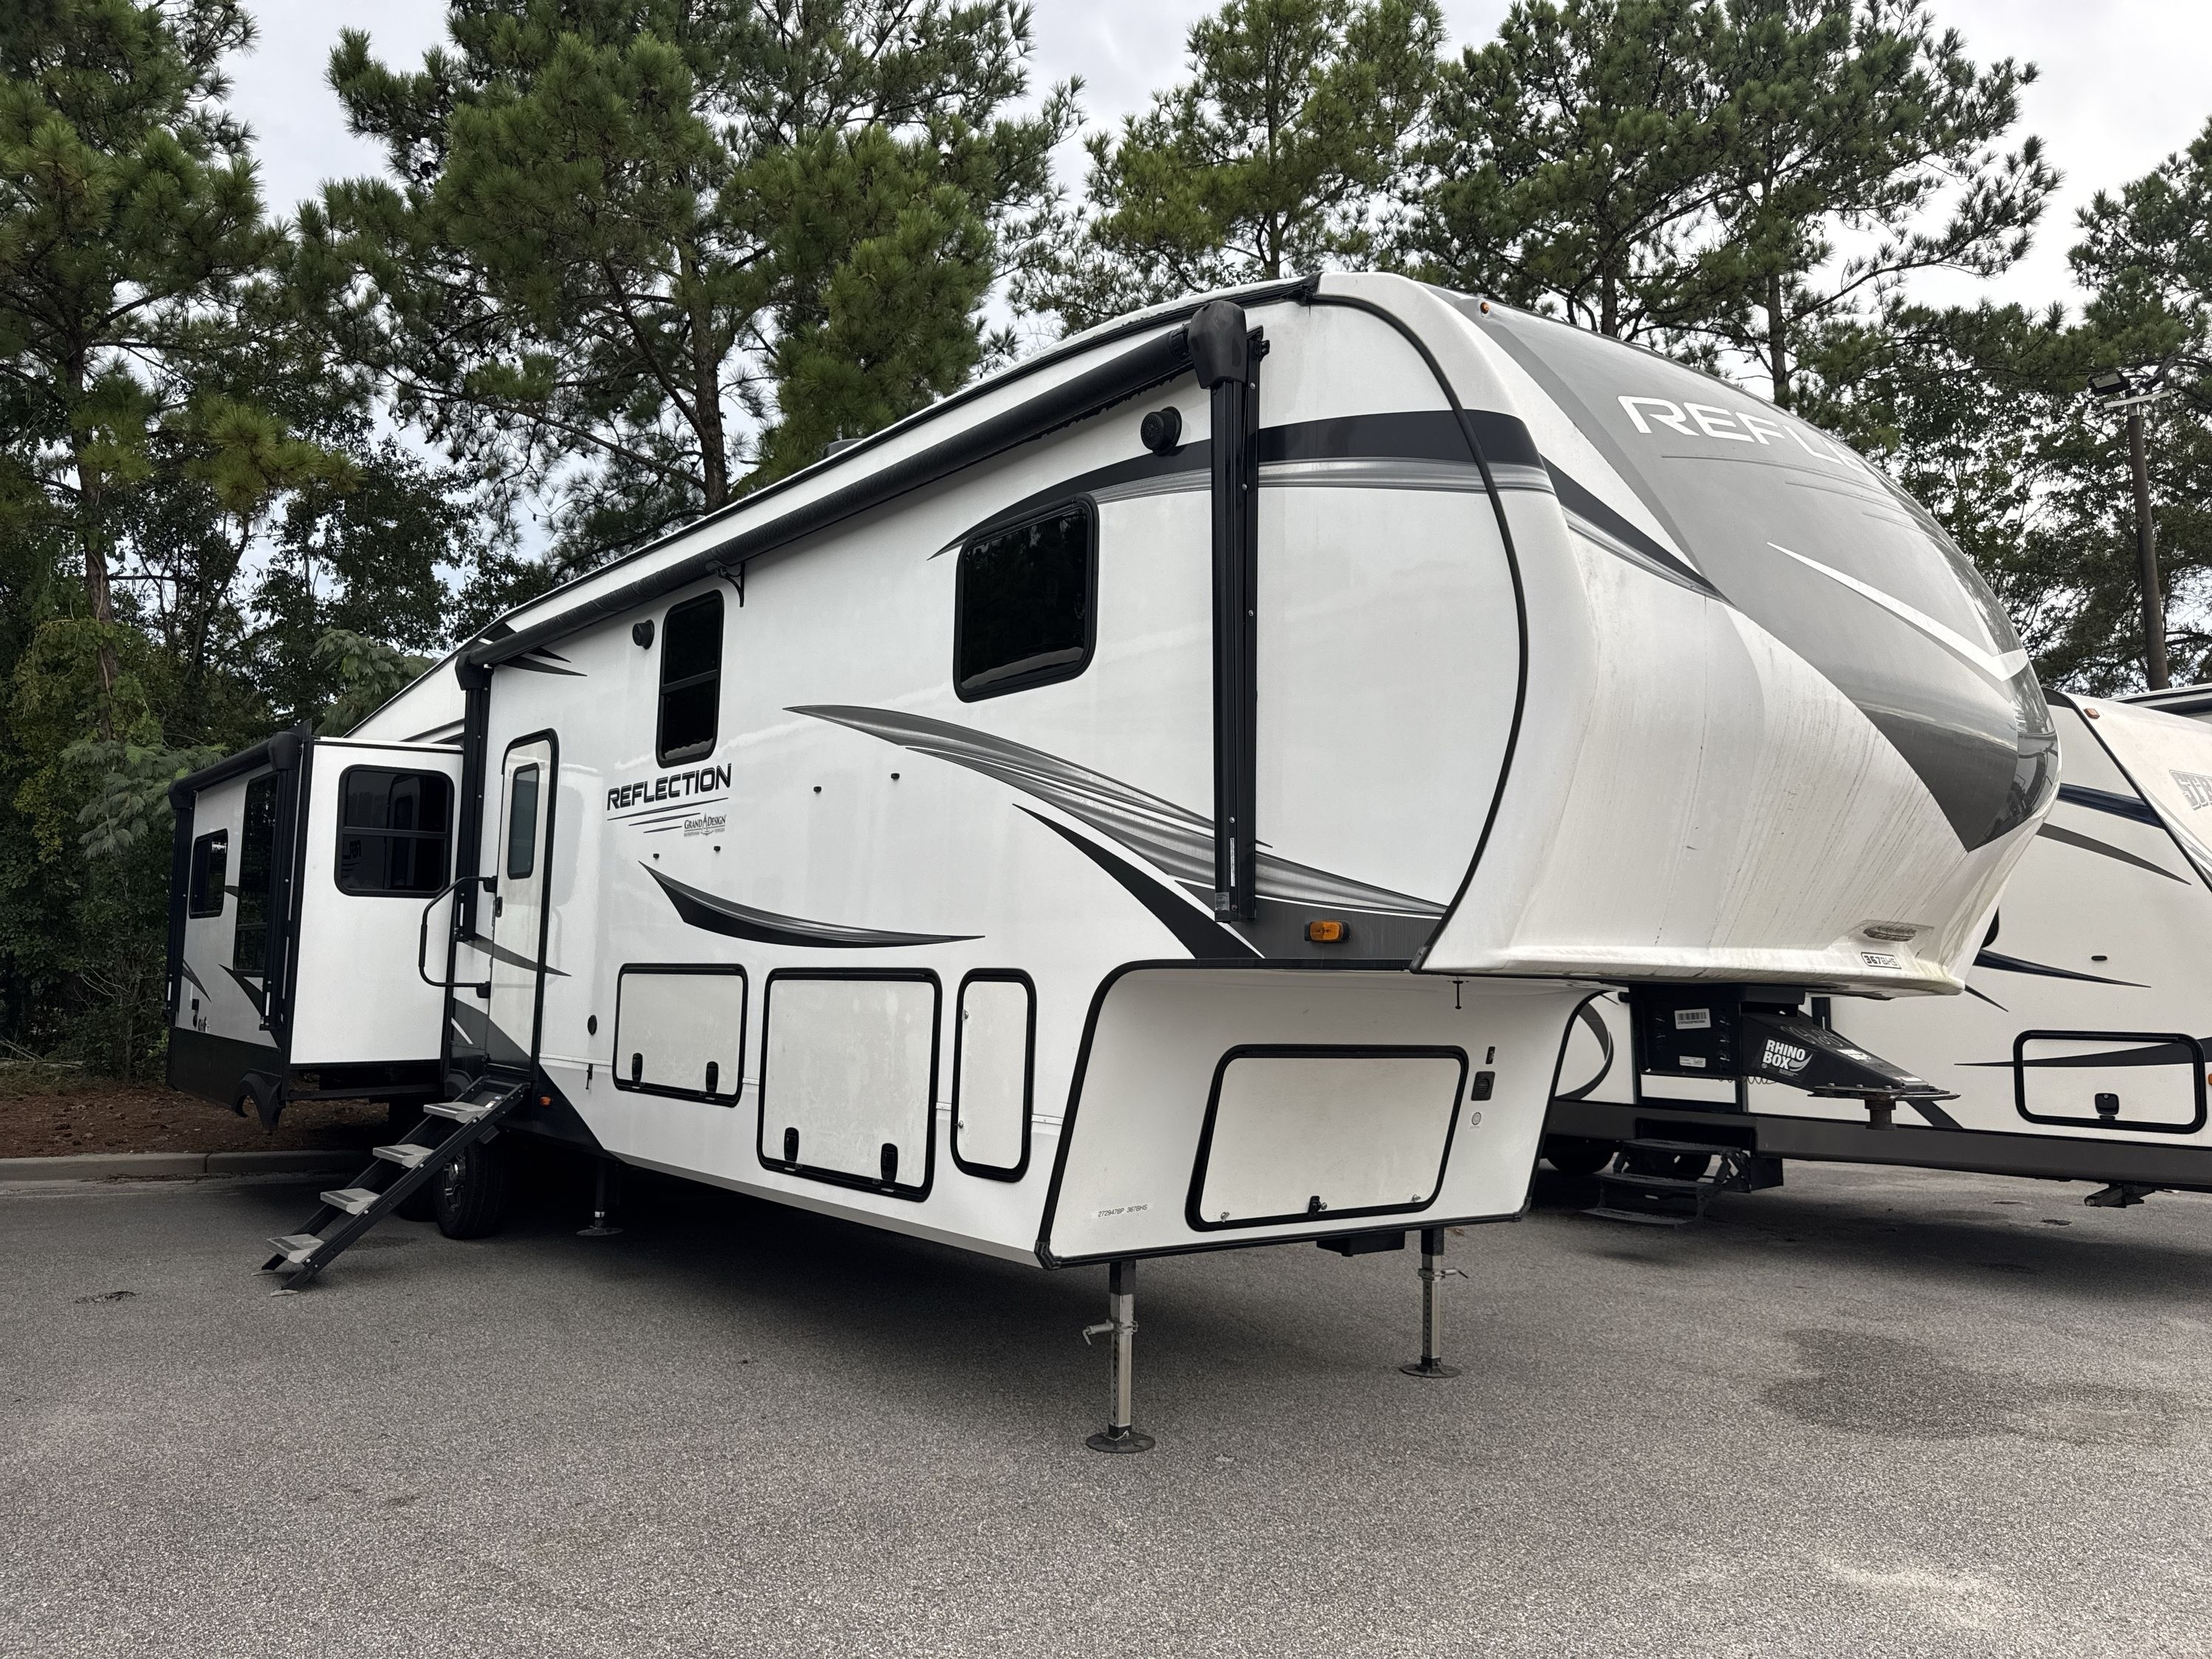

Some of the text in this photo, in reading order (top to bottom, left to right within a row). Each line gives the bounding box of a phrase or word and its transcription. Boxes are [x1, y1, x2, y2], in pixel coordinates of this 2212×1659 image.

[607, 762, 732, 811] REFLECTION
[684, 815, 726, 830] GRAND DESIGN
[1863, 955, 1898, 967] 367BHS
[1762, 1050, 1792, 1070] BOX
[1765, 1039, 1806, 1061] RHINO
